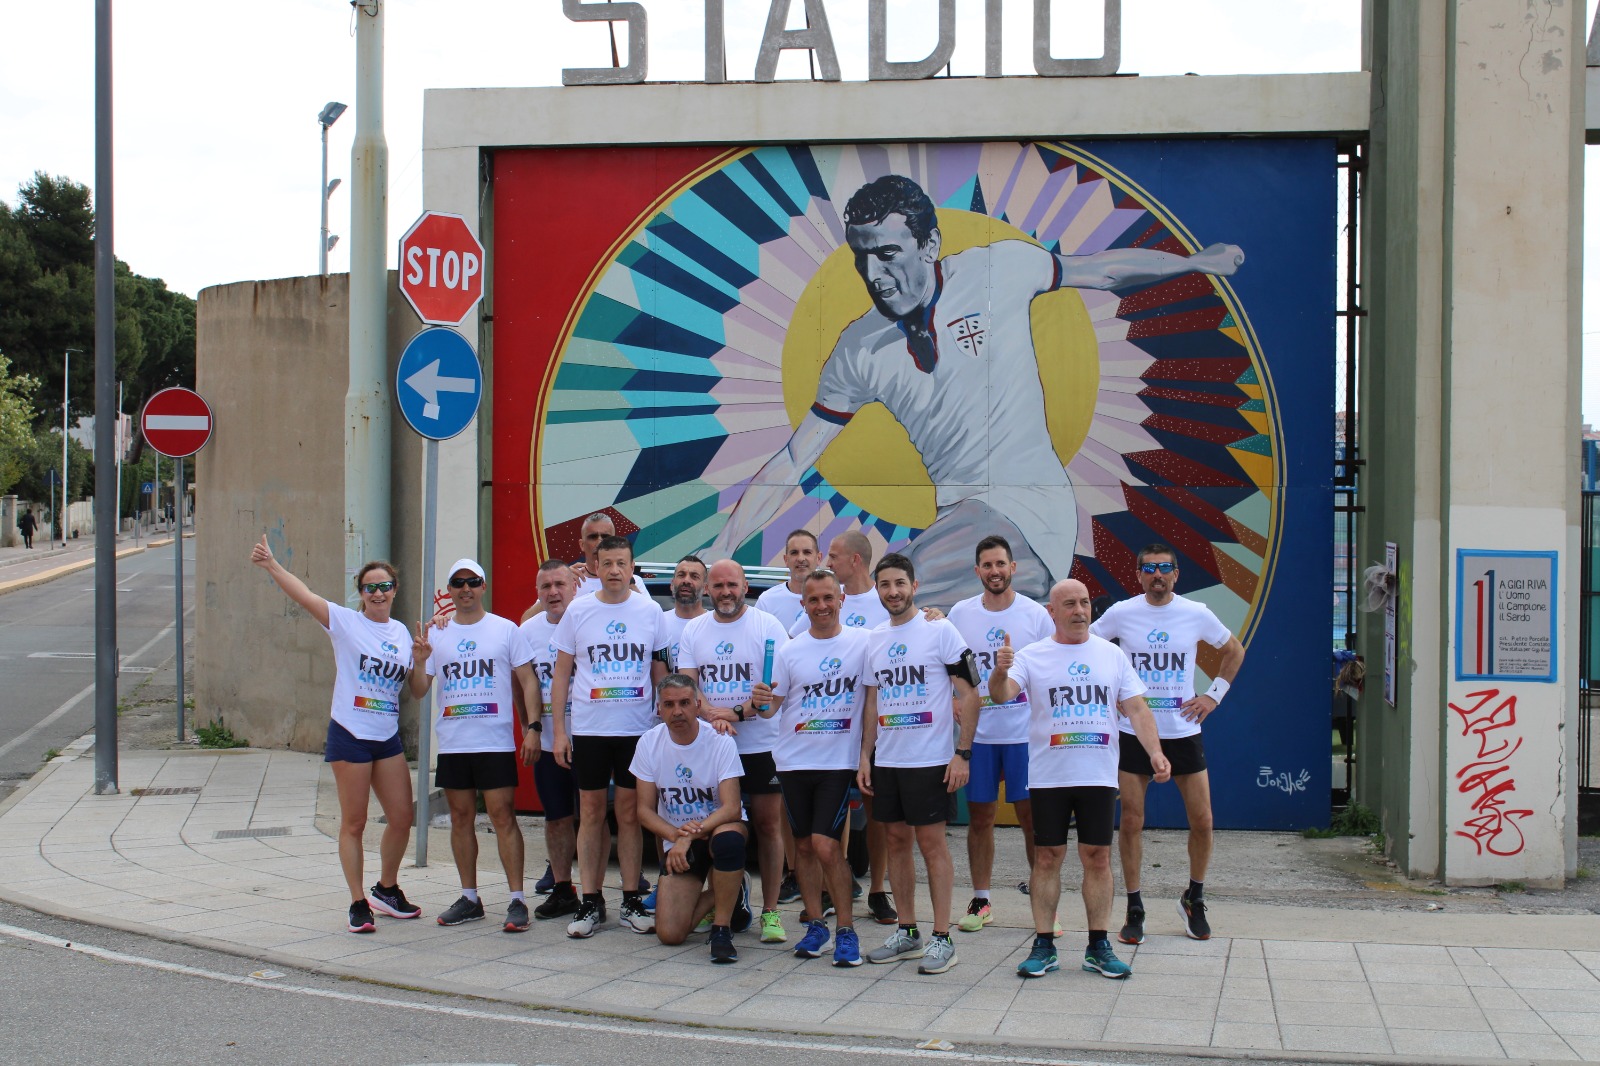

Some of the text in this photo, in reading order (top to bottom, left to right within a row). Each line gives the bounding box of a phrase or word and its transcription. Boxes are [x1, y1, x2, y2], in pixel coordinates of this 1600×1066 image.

[407, 245, 479, 291] STOP
[1499, 579, 1547, 590] A GIGI RIVA
[1506, 591, 1530, 600] Uomo
[1506, 601, 1547, 613] Campione
[1506, 612, 1530, 621] Sardo
[587, 643, 645, 664] RUN
[889, 657, 906, 665] AIRC
[1131, 652, 1186, 671] RUN
[360, 653, 409, 682] RUN
[442, 658, 494, 680] RUN
[699, 662, 751, 682] RUN
[358, 671, 399, 692] 4HOPE
[874, 665, 926, 690] RUN
[1138, 670, 1185, 683] HOPE
[600, 689, 639, 697] MASSIGEN
[802, 674, 858, 700] RUN
[881, 683, 927, 700] HOPE
[1048, 684, 1108, 707] RUN
[1147, 699, 1177, 707] ASSIGEN
[450, 705, 488, 714] MASSIGEN
[1052, 703, 1108, 719] 4HOPE
[883, 715, 921, 725] MASSIGEN
[1060, 734, 1103, 743] MASSIGEN
[660, 786, 714, 805] RUN
